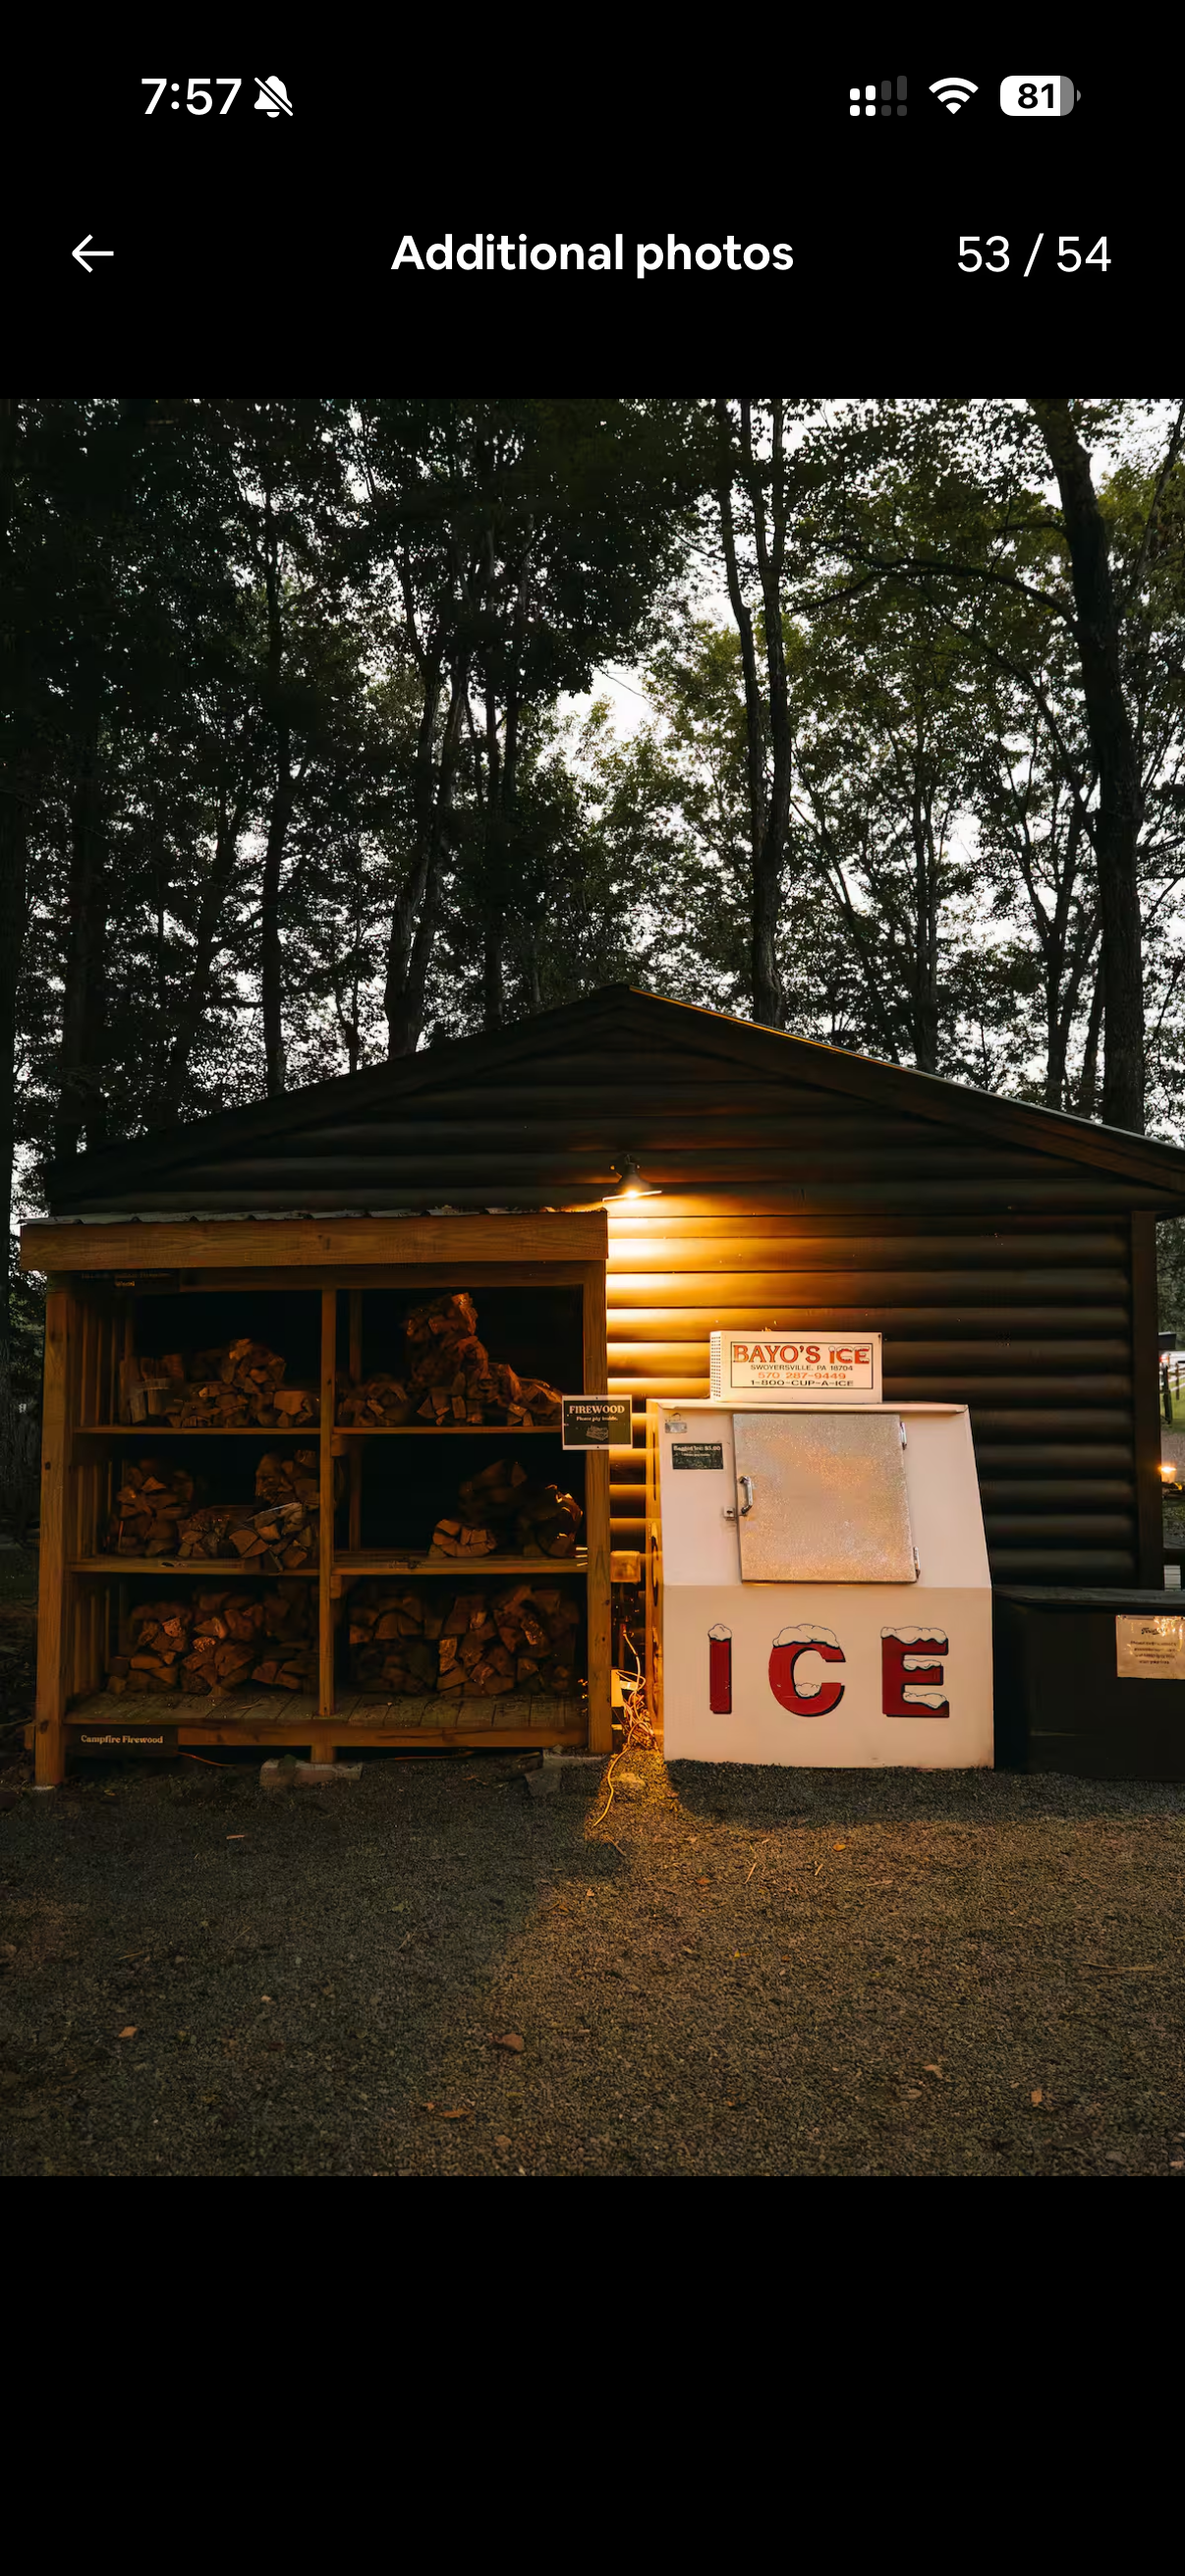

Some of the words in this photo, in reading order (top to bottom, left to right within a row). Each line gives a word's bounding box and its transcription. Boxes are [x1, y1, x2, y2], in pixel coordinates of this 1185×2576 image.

[733, 1345, 820, 1364] BAYO'S
[569, 1405, 625, 1414] FIREWOOD
[707, 1623, 950, 1718] ICE
[81, 1735, 121, 1745] Campfire
[122, 1735, 163, 1744] Firewood
